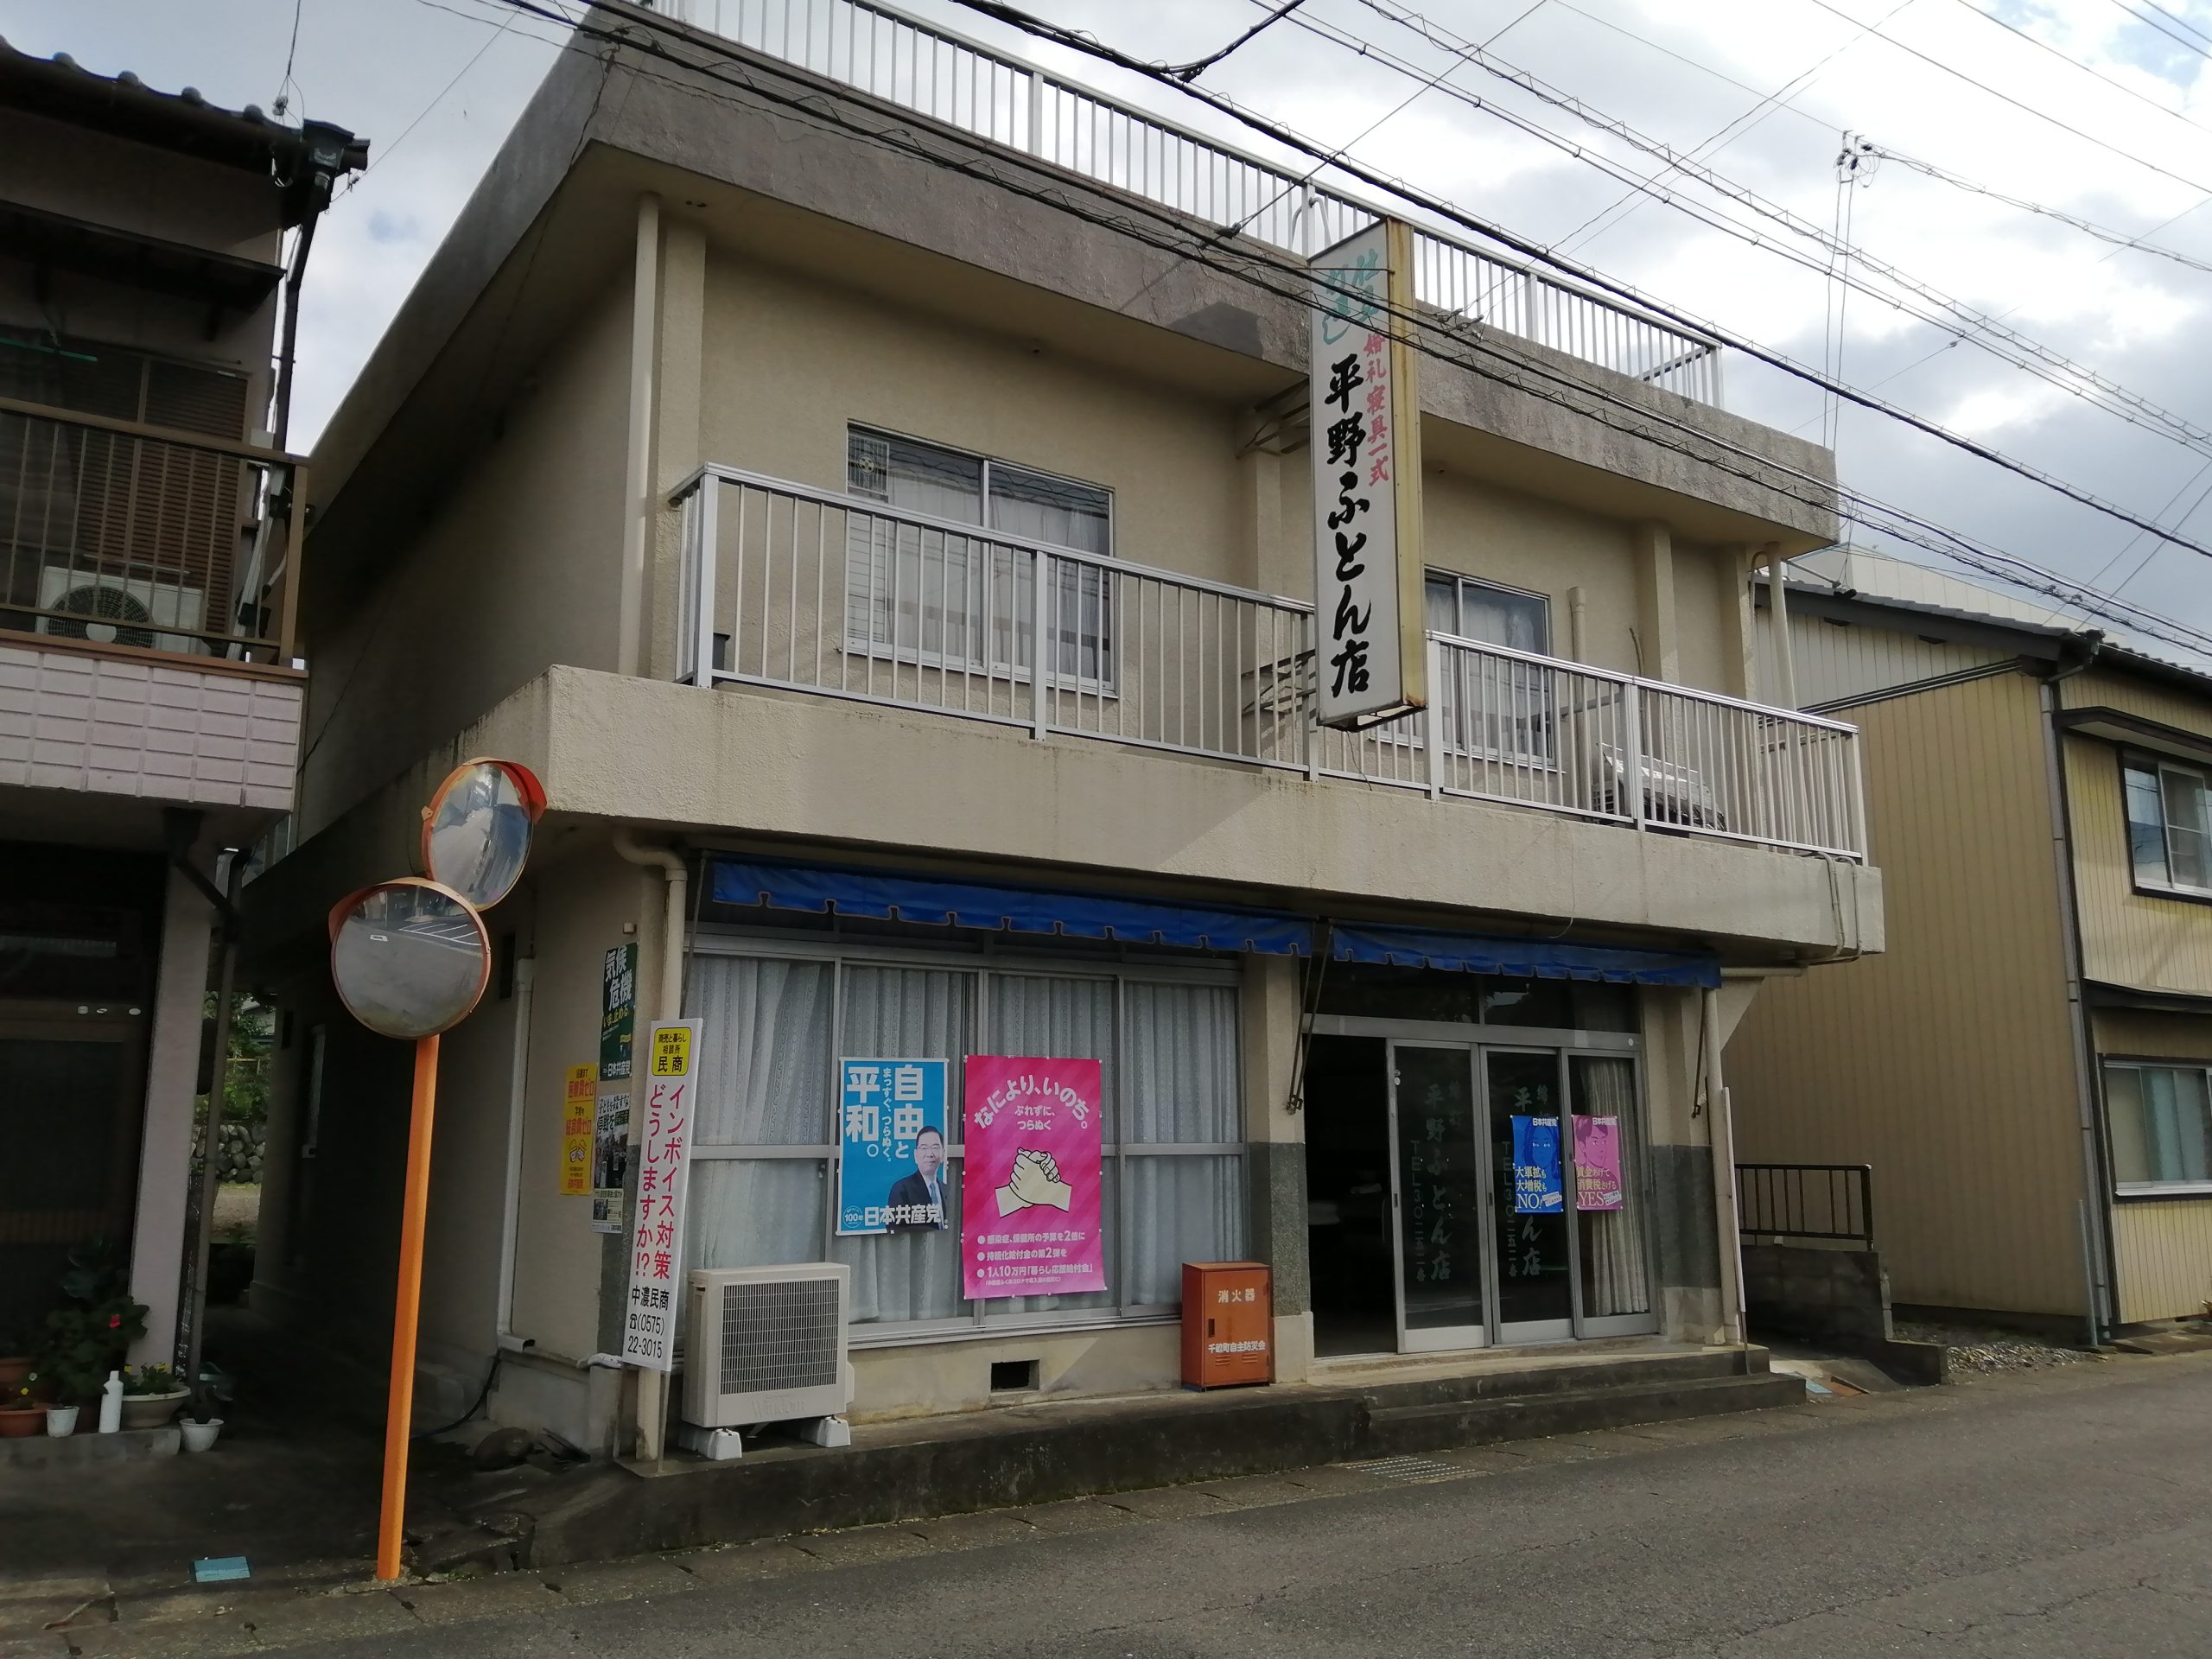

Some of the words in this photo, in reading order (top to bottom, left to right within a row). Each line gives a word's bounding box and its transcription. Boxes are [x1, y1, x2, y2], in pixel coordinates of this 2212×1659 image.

[1363, 332, 1389, 487] 婚礼寝具一式
[1324, 353, 1370, 697] 平野ふとん店
[606, 945, 627, 982] 気候
[608, 969, 632, 1012] 危機
[658, 1055, 683, 1072] 民商
[845, 1066, 880, 1158] 平和。
[893, 1064, 924, 1159] 自由と
[974, 1074, 1090, 1129] なにより、いのち。
[1014, 1105, 1056, 1116] ぶれずに、
[1017, 1120, 1052, 1130] つらぬく
[652, 1084, 684, 1280] インボイス対策
[1424, 1083, 1453, 1281] 平野ふとん店
[1516, 1166, 1547, 1179] 大軍拡も
[1516, 1179, 1548, 1192] 大増税も
[1516, 1192, 1544, 1209] NO!
[1578, 1191, 1605, 1206] YES
[864, 1203, 942, 1226] 日本共産党
[632, 1285, 670, 1311] 中濃民商
[1217, 1287, 1256, 1303] 消火器
[627, 1335, 663, 1358] 22-3015
